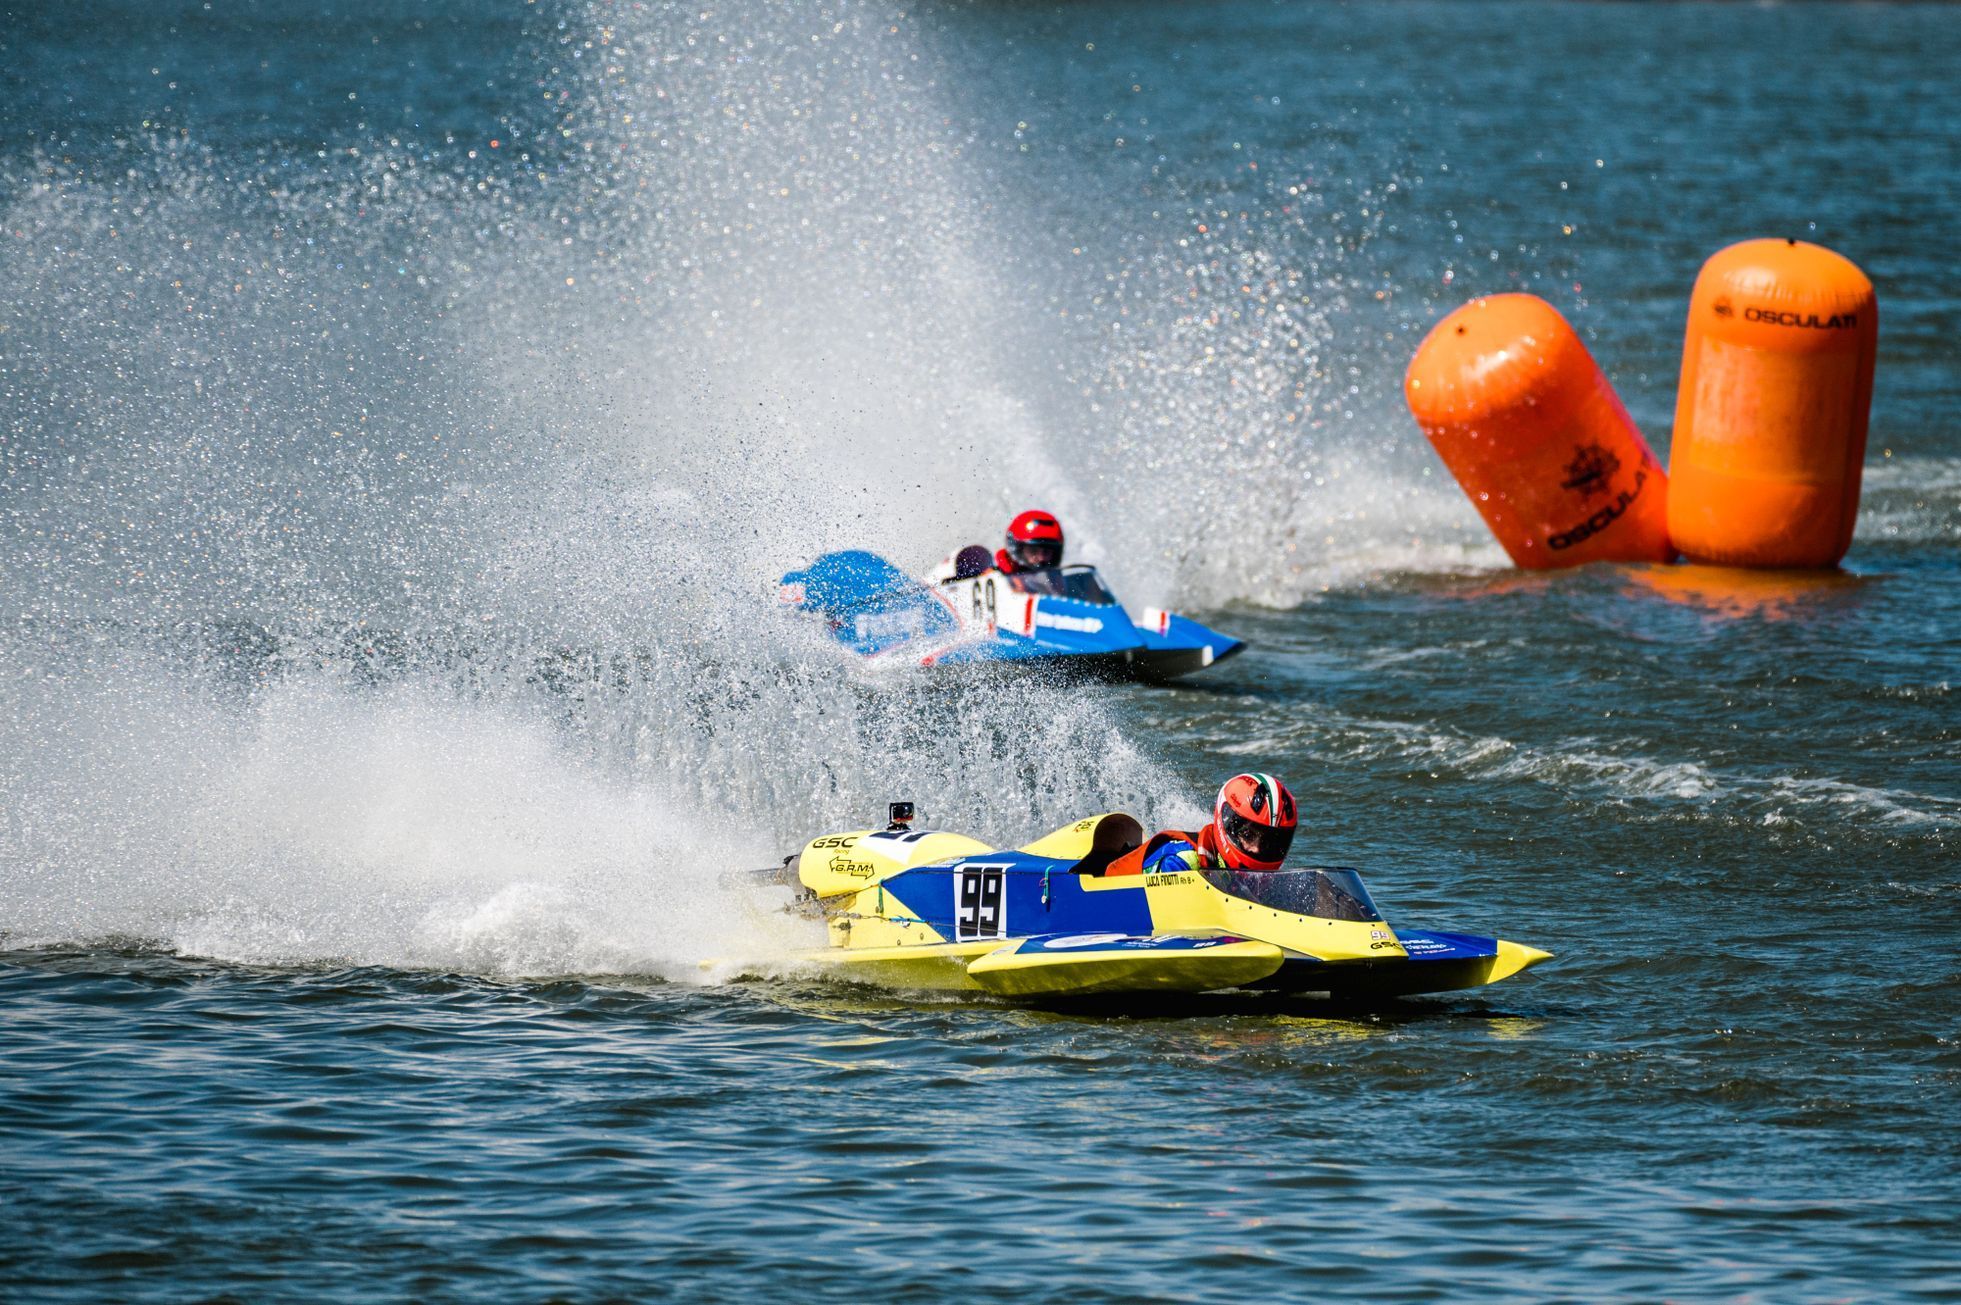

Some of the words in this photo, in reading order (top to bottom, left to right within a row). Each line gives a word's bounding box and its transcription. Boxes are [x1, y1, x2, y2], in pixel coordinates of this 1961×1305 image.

[812, 836, 859, 849] GSC
[1146, 875, 1160, 887] LUCA
[959, 867, 1003, 937] 99
